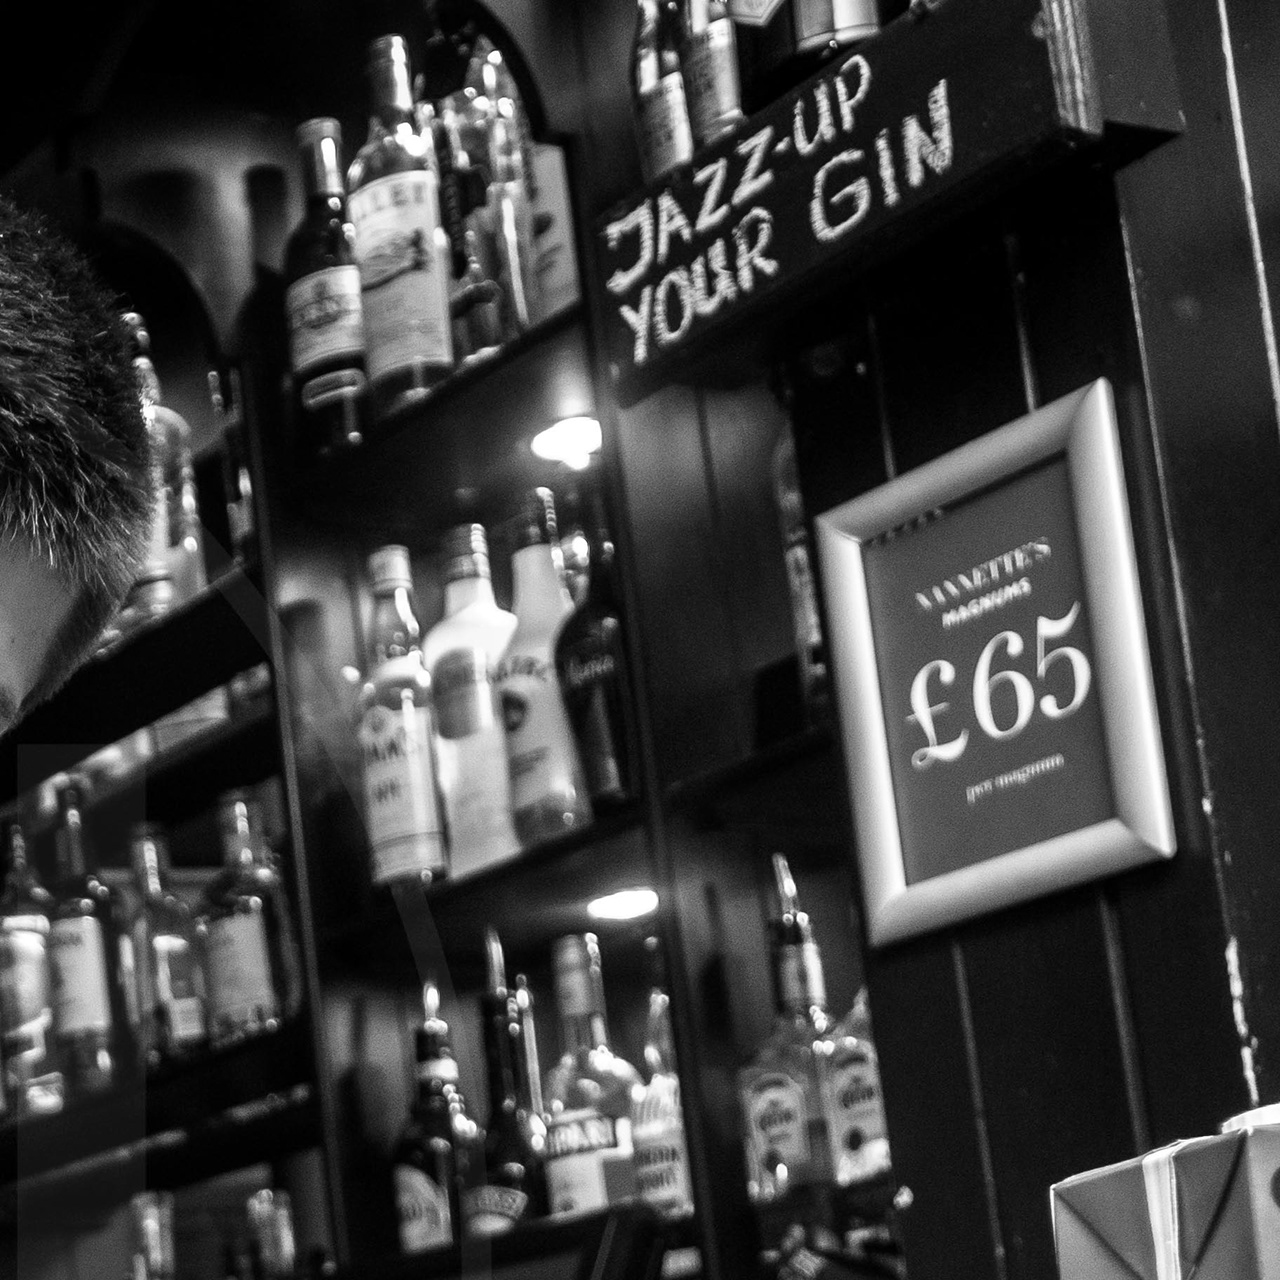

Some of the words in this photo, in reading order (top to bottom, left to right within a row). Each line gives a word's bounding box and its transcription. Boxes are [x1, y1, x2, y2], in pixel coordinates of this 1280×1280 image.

[605, 54, 872, 294] JAZZ-UP
[619, 207, 778, 364] YOUR
[809, 78, 955, 243] GIN
[905, 601, 1091, 771] £65
